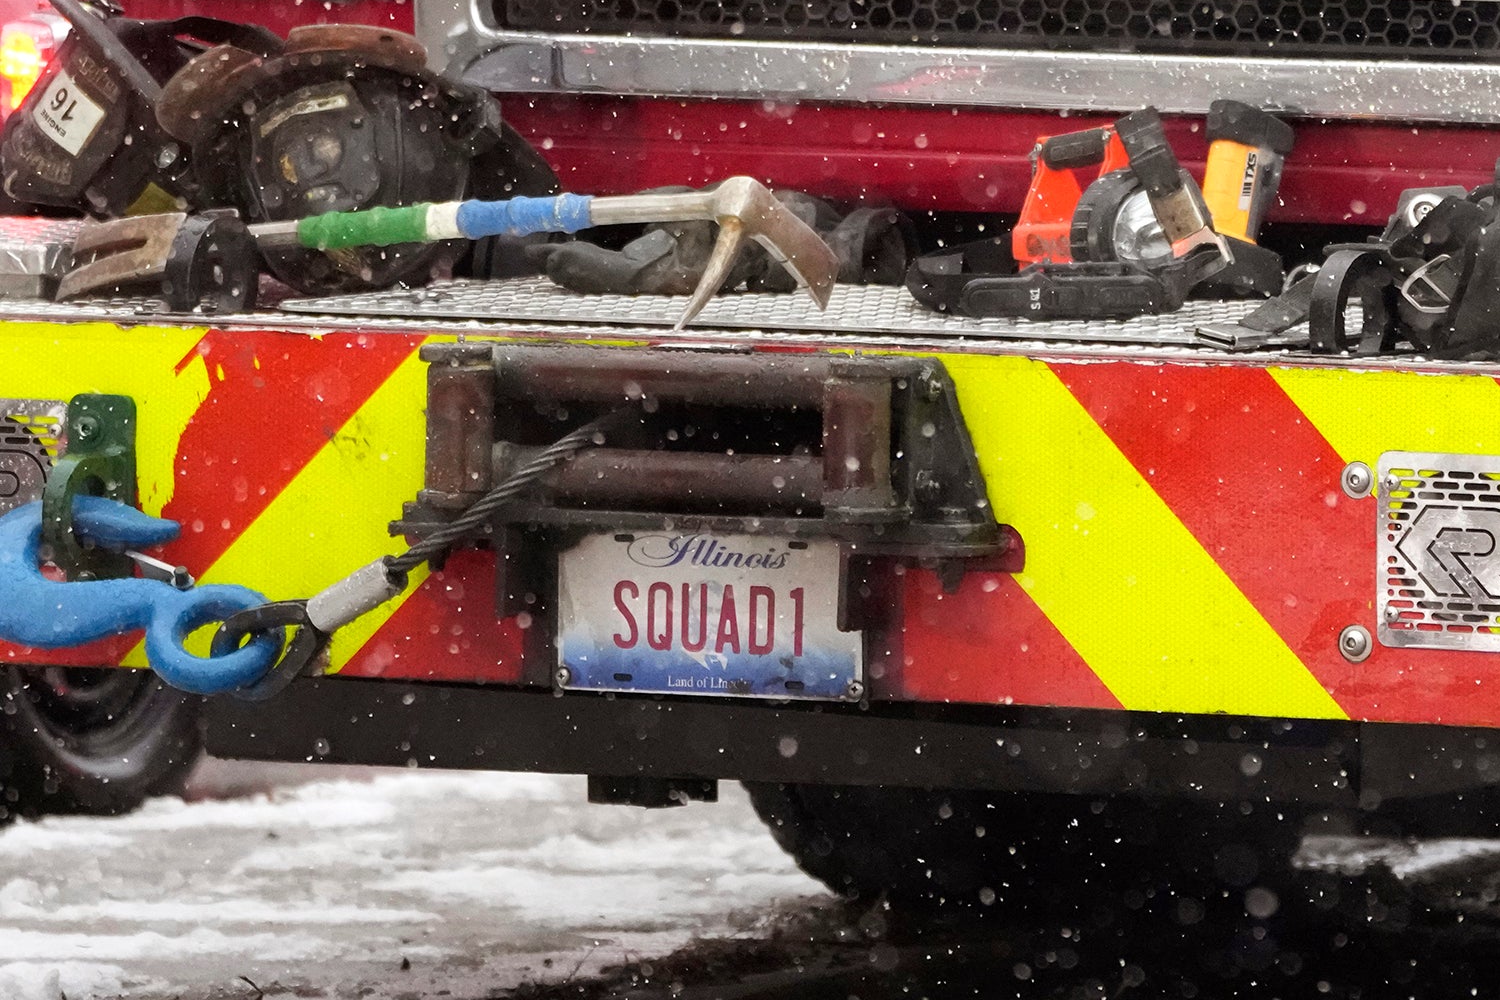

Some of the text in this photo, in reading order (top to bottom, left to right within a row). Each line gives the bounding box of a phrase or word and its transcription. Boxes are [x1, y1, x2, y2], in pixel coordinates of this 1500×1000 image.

[50, 88, 77, 121] 16
[40, 108, 67, 138] ENGINE
[627, 533, 790, 570] Illinois
[612, 579, 805, 658] SQUAD1
[667, 675, 694, 688] Land
[696, 676, 708, 688] of
